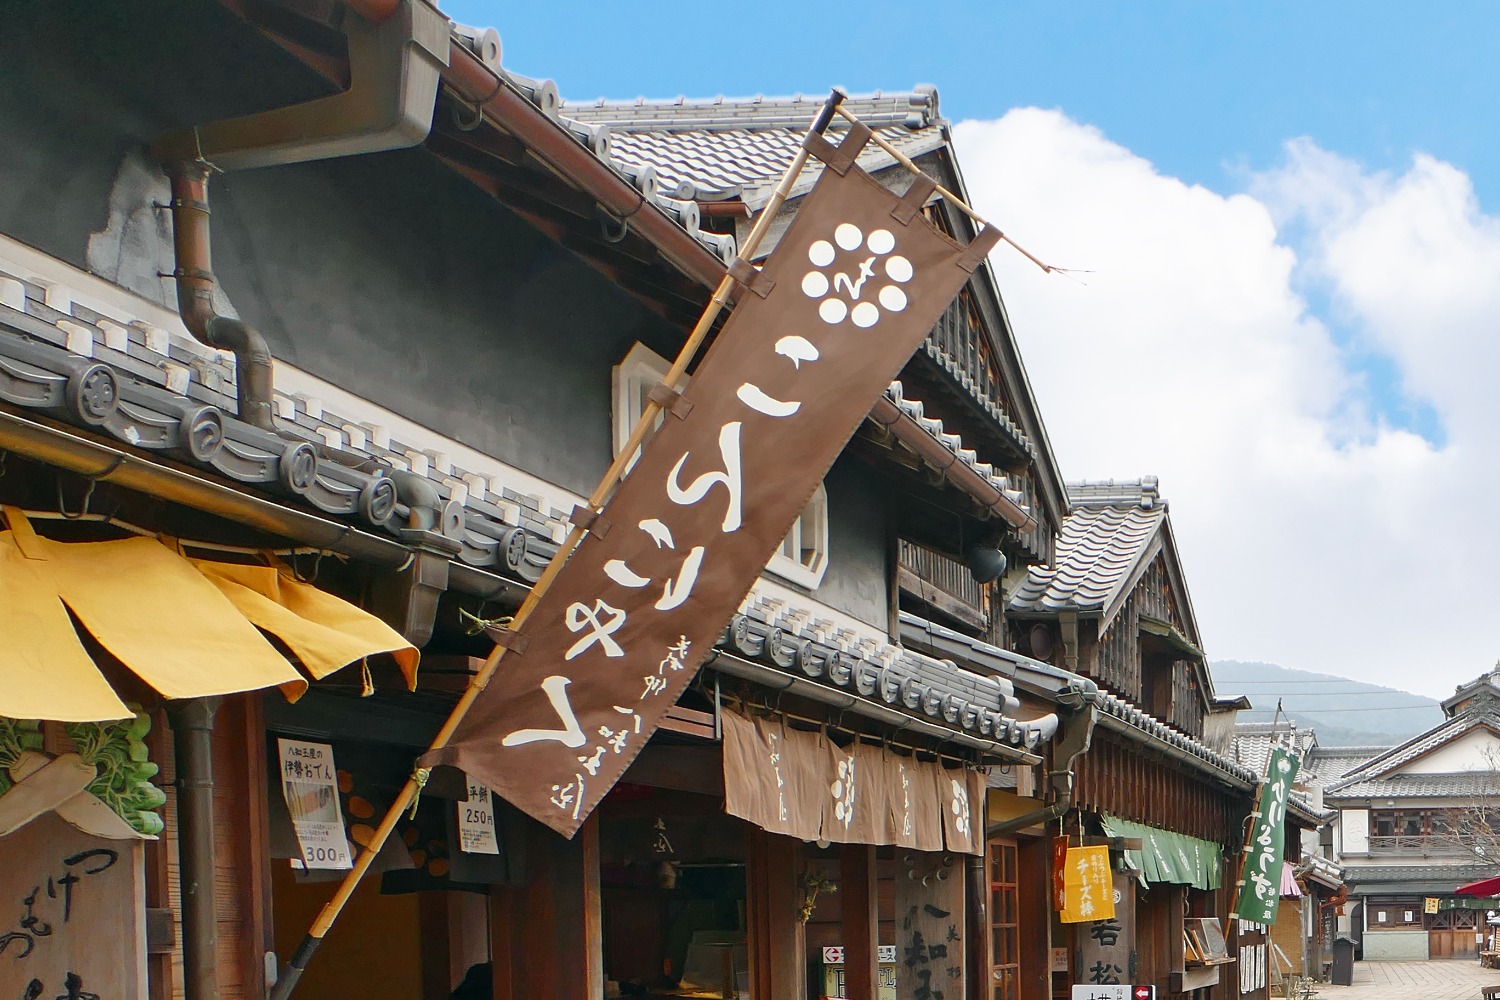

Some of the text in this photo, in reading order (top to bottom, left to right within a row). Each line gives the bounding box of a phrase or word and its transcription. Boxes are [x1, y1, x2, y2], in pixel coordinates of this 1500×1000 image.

[284, 760, 333, 780] 伊勢おでん
[466, 808, 494, 825] 250円
[305, 846, 347, 862] 300円
[1076, 857, 1095, 917] チーズ棒
[0, 848, 119, 959] つけもの
